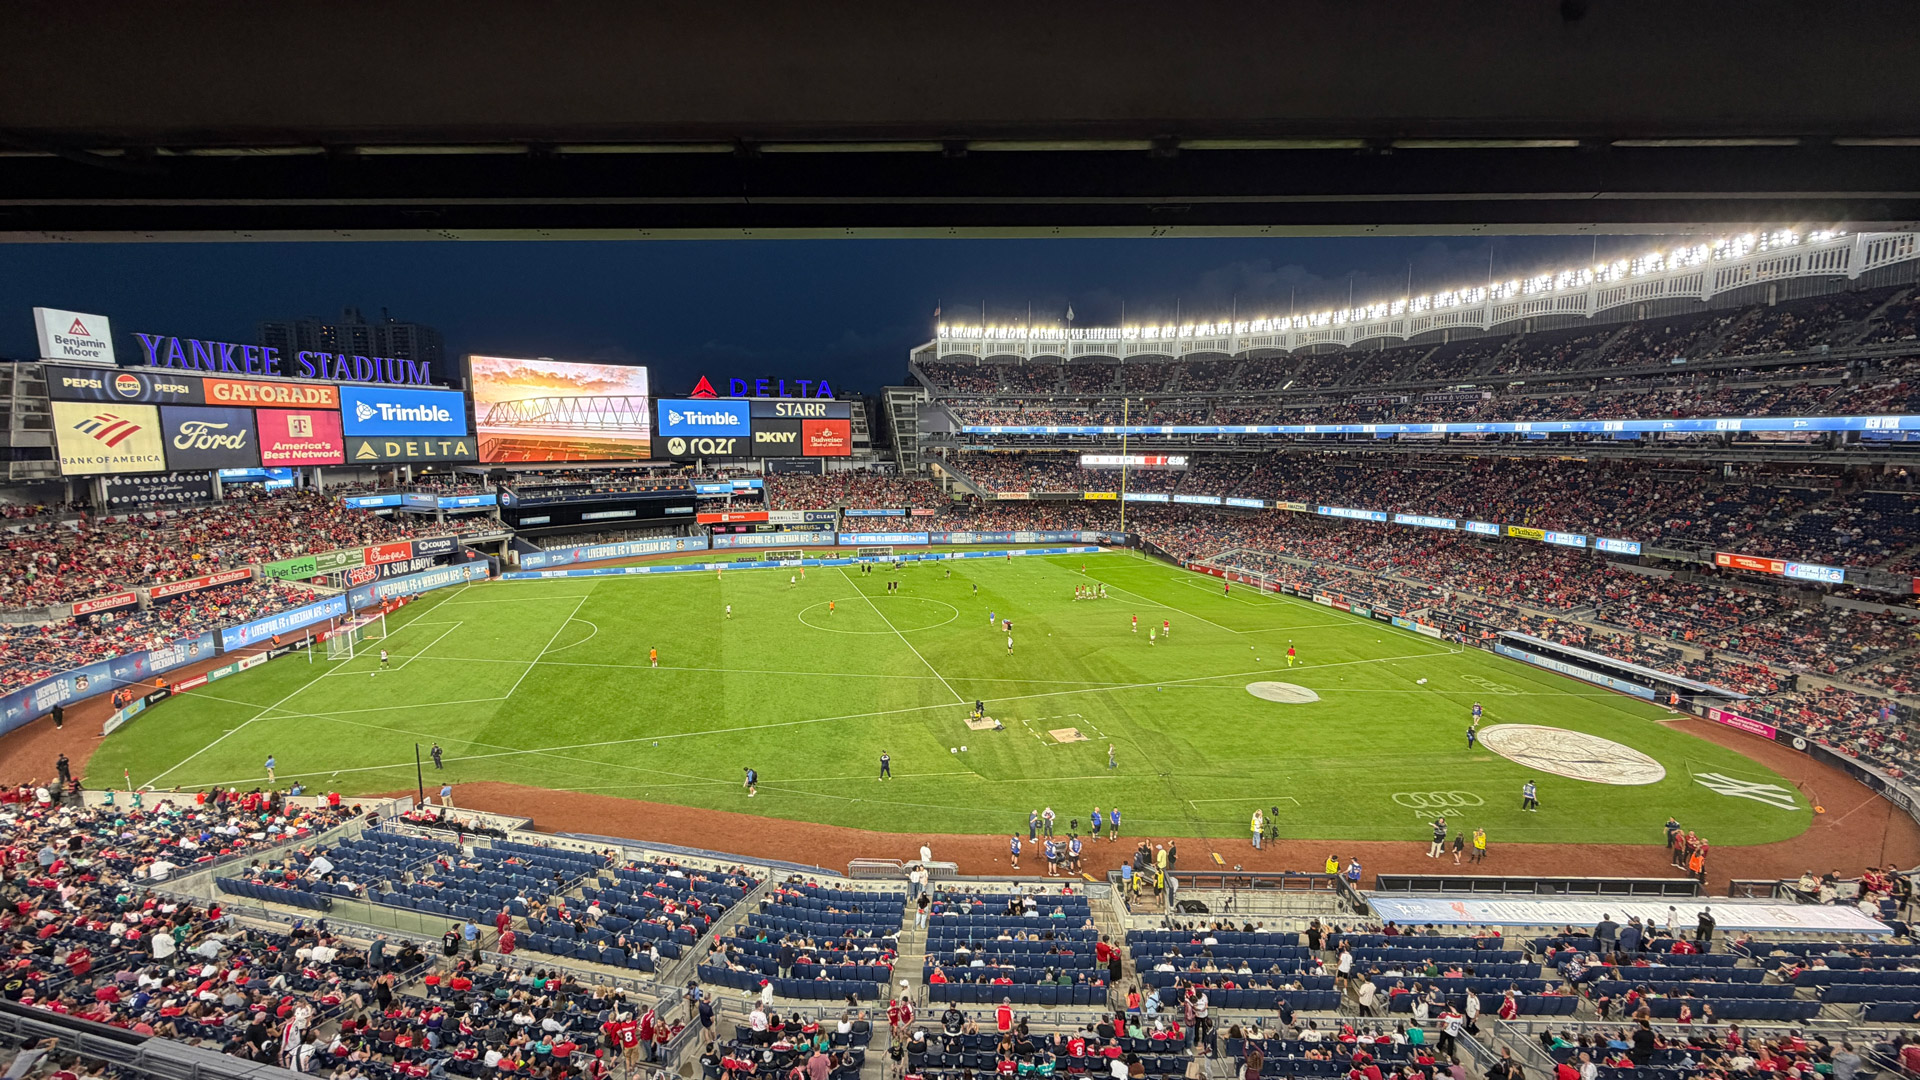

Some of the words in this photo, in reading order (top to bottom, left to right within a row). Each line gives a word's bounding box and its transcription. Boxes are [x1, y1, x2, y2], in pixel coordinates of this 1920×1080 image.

[54, 335, 106, 349] Benjamin
[63, 346, 99, 358] Moore
[135, 332, 281, 376] YANKEE
[299, 350, 432, 385] STADIUM
[63, 377, 102, 389] PEPSI
[117, 382, 140, 390] PEPSI
[154, 383, 189, 394] PEPSI
[730, 378, 833, 398] DELTA
[213, 384, 333, 404] GATORADE
[775, 403, 826, 416] STARR
[173, 420, 247, 450] Ford
[755, 432, 797, 443] DKNY
[272, 442, 331, 450] America's
[386, 441, 469, 457] DELTA
[690, 438, 736, 454] razr
[62, 456, 93, 465] BANK
[96, 456, 110, 464] OF
[113, 455, 161, 464] AMERICA
[264, 451, 292, 460] Best
[293, 450, 341, 459] Network
[428, 540, 451, 549] coupa
[739, 536, 763, 545] LIVERPOOL
[588, 546, 616, 558] LIVERPOOL
[618, 544, 625, 555] FC
[631, 542, 659, 554] WREXHAM
[660, 541, 671, 551] AFC
[267, 569, 289, 578] Uber
[291, 563, 315, 576] Eats
[383, 565, 390, 577] A
[391, 561, 409, 574] SUB
[410, 557, 436, 571] ABOVE
[379, 583, 409, 596] LIVERPOOL
[422, 573, 450, 588] WREXHAM
[450, 569, 460, 581] AFC
[251, 620, 278, 637] LIVERPOOL
[289, 609, 313, 625] WREXHAM
[313, 606, 322, 618] AFC
[1415, 808, 1464, 819] Audi
[624, 1031, 633, 1042] 8
[1077, 1047, 1083, 1057] 8
